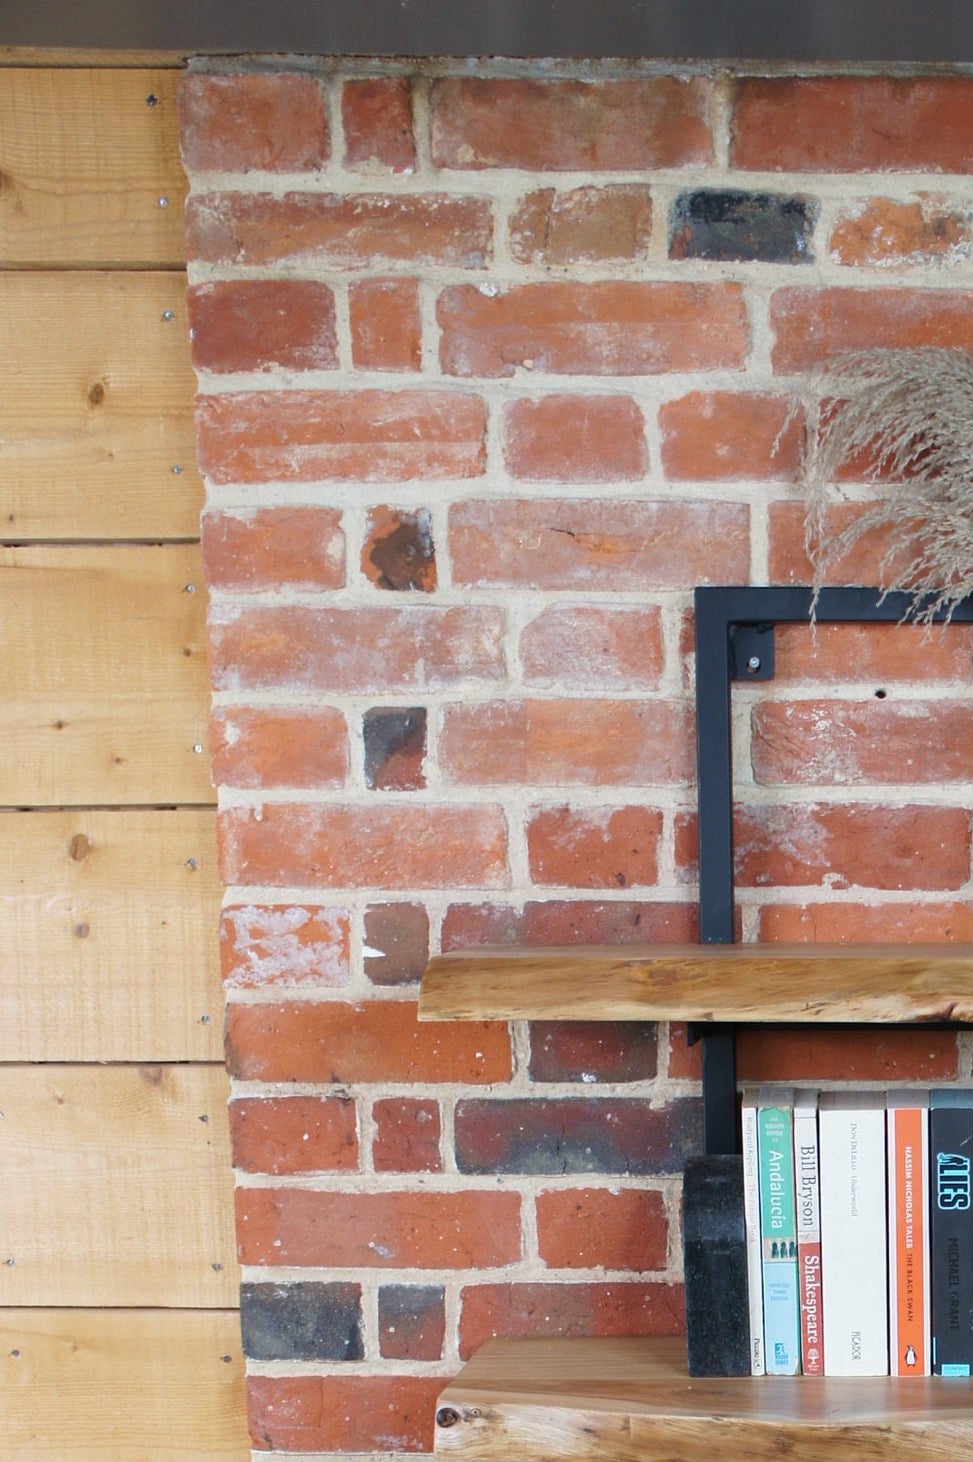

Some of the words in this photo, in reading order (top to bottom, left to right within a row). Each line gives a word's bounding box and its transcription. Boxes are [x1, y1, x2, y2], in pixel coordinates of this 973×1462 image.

[746, 1117, 755, 1149] Rudyard
[746, 1149, 755, 1177] Kipling
[801, 1145, 815, 1170] Bill
[904, 1146, 913, 1179] NASSIM
[799, 1177, 816, 1226] Bryson
[850, 1175, 859, 1217] Underworld
[940, 1162, 970, 1209] LIES
[904, 1181, 914, 1224] NICHOLAS
[905, 1225, 914, 1249] TALEB
[906, 1253, 914, 1268] THE
[947, 1238, 960, 1289] MICHAEL
[906, 1269, 914, 1295] BLACK
[802, 1255, 821, 1344] Shakespeare
[906, 1297, 915, 1322] SWAN
[948, 1291, 961, 1332] GRANT
[851, 1331, 861, 1360] PICADOR
